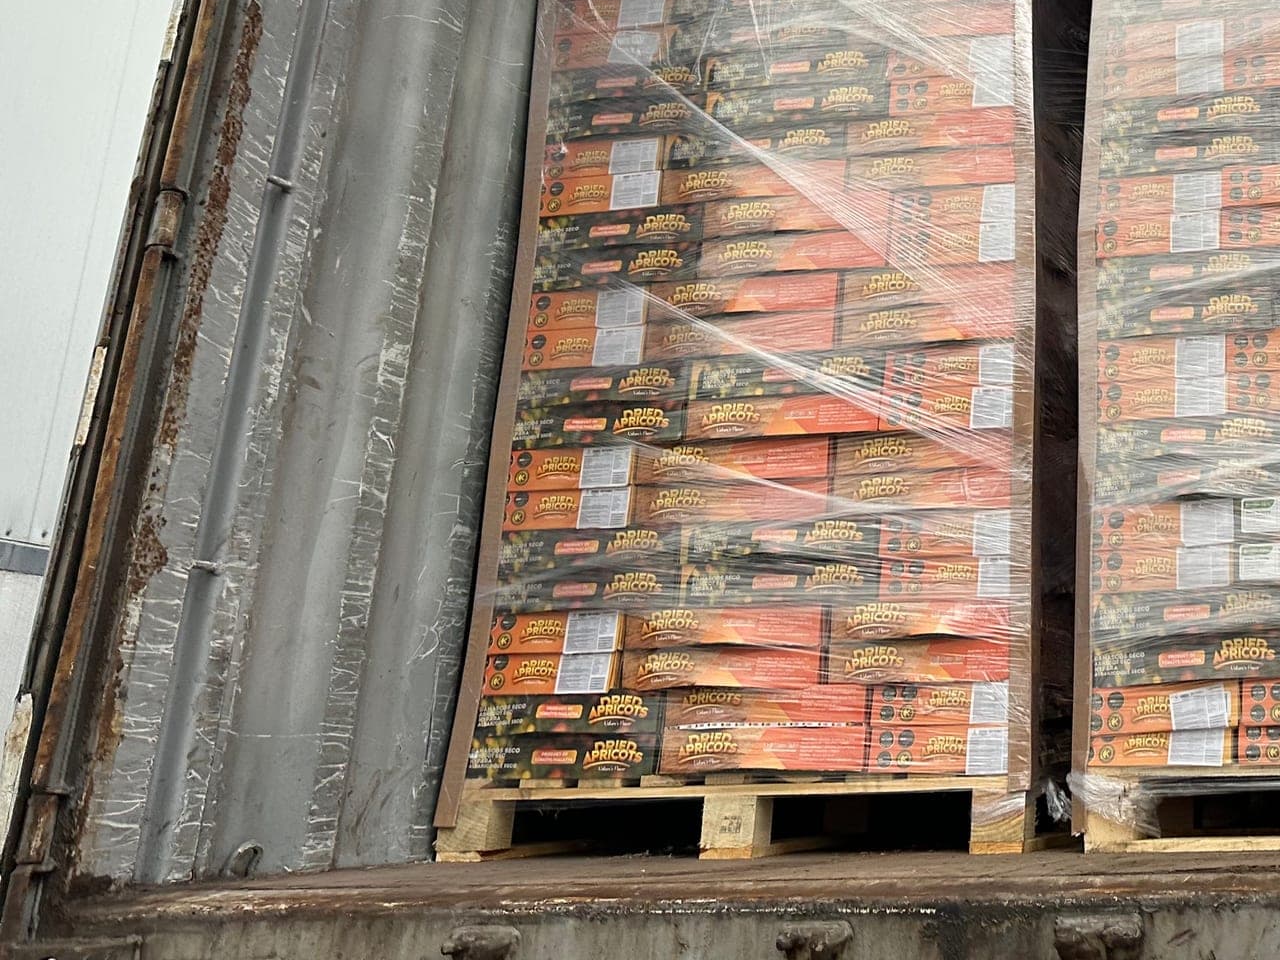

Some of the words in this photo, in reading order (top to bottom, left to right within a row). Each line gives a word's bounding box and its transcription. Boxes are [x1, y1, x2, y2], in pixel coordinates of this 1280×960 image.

[826, 51, 865, 60] DRIED
[818, 58, 869, 70] APRICOTS
[830, 86, 868, 96] DRIED
[822, 93, 874, 106] APRICOTS
[648, 103, 688, 111] DRIED
[640, 109, 691, 121] APRICOTS
[870, 121, 910, 130] DRIED
[786, 130, 825, 138] DRIED
[861, 128, 914, 140] APRICOTS
[778, 136, 830, 147] APRICOTS
[688, 171, 728, 180] DRIED
[576, 184, 606, 192] DRIED
[680, 178, 732, 192] APRICOTS
[568, 190, 610, 200] APRICOTS
[730, 202, 770, 211] DRIED
[646, 214, 685, 224] DRIED
[721, 208, 776, 221] APRICOTS
[636, 222, 691, 234] APRICOTS
[727, 241, 766, 250] DRIED
[638, 250, 678, 260] DRIED
[719, 248, 772, 261] APRICOTS
[628, 257, 683, 270] APRICOTS
[676, 283, 716, 292] DRIED
[667, 290, 721, 302] APRICOTS
[868, 311, 910, 321] DRIED
[860, 318, 917, 331] APRICOTS
[559, 338, 590, 346] DRIED
[551, 344, 593, 354] APRICOTS
[629, 368, 669, 378] DRIED
[619, 375, 675, 387] APRICOTS
[712, 402, 754, 413] DRIED
[624, 408, 662, 418] DRIED
[701, 410, 760, 424] APRICOTS
[613, 416, 670, 428] APRICOTS
[864, 438, 906, 448] DRIED
[662, 447, 703, 457] DRIED
[854, 446, 912, 458] APRICOTS
[544, 456, 576, 464] DRIED
[652, 455, 709, 468] APRICOTS
[537, 462, 580, 473] APRICOTS
[861, 477, 904, 487] DRIED
[659, 489, 700, 498] DRIED
[852, 485, 910, 498] APRICOTS
[542, 496, 572, 504] DRIED
[650, 496, 706, 510] APRICOTS
[534, 502, 577, 512] APRICOTS
[815, 521, 857, 530] DRIED
[616, 530, 658, 540] DRIED
[804, 528, 862, 541] APRICOTS
[606, 538, 664, 550] APRICOTS
[814, 565, 857, 574] DRIED
[614, 572, 656, 582] DRIED
[805, 573, 864, 587] APRICOTS
[602, 581, 662, 592] APRICOTS
[856, 603, 900, 613] DRIED
[651, 611, 694, 620] DRIED
[847, 612, 906, 624] APRICOTS
[529, 620, 561, 629] DRIED
[641, 618, 699, 632] APRICOTS
[1221, 638, 1267, 648] DRIED
[647, 652, 690, 662] DRIED
[852, 647, 897, 657] DRIED
[1213, 646, 1276, 663] APRICOTS
[522, 660, 554, 668] DRIED
[638, 660, 694, 674] APRICOTS
[845, 655, 903, 670] APRICOTS
[600, 695, 642, 706] DRIED
[682, 692, 741, 706] APRICOTS
[589, 703, 648, 718] APRICOTS
[688, 732, 732, 743] DRIED
[594, 740, 636, 750] DRIED
[679, 742, 738, 756] APRICOTS
[583, 748, 642, 763] APRICOTS
